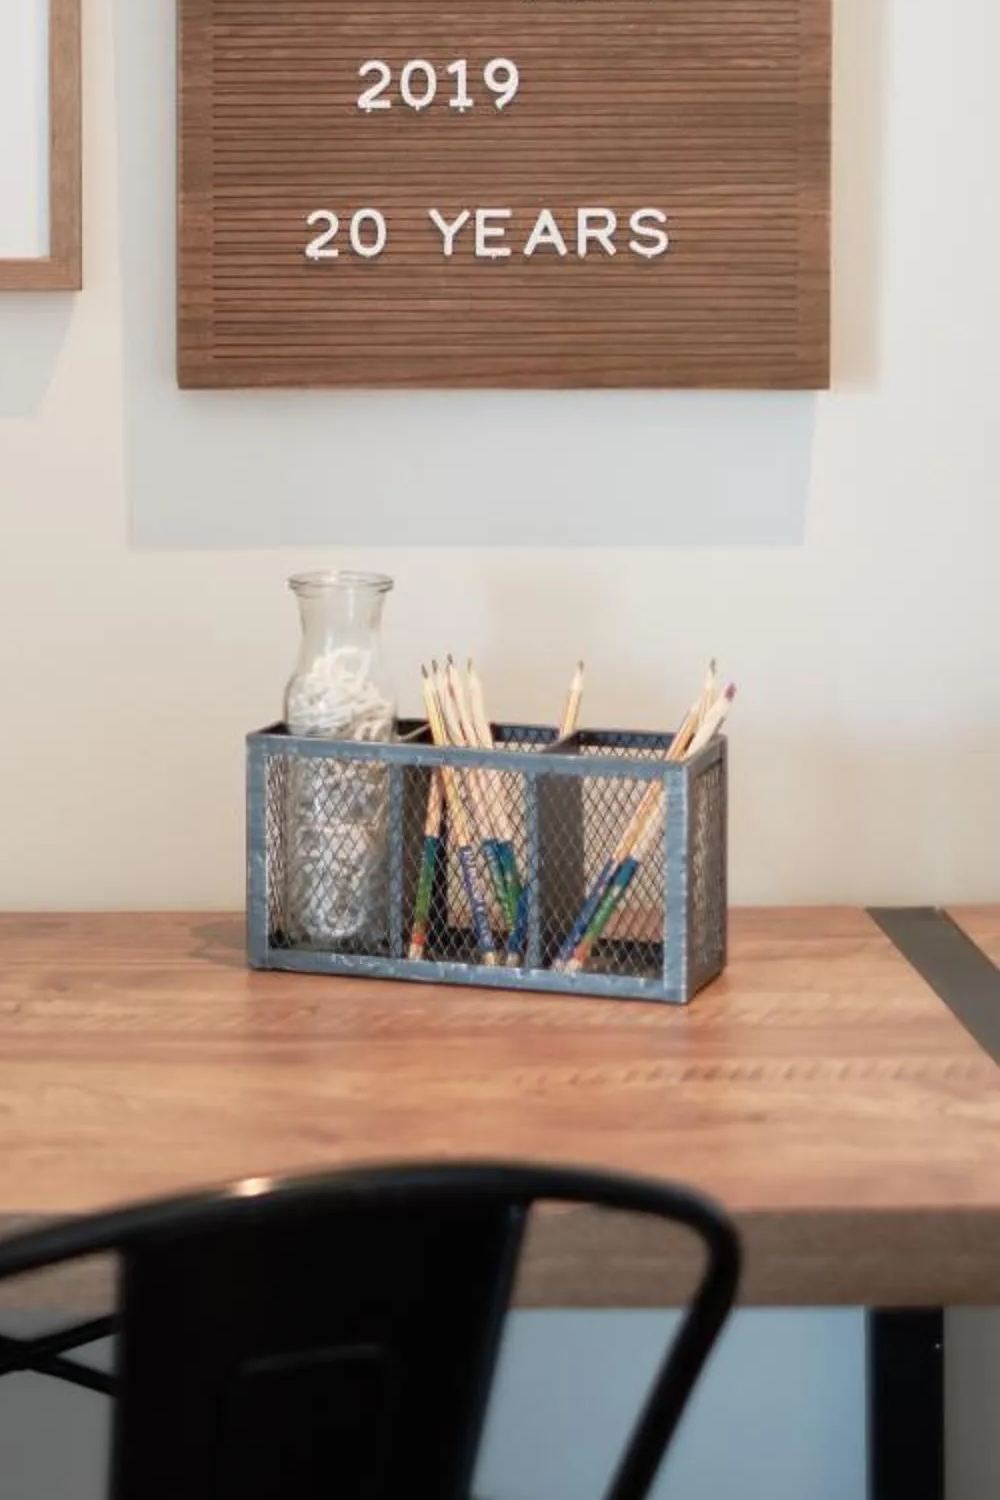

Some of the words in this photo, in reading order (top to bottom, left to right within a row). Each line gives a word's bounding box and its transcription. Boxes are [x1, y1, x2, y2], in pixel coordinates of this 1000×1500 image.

[357, 58, 519, 112] 2019
[305, 208, 387, 261] 20
[429, 207, 669, 259] YEARS
